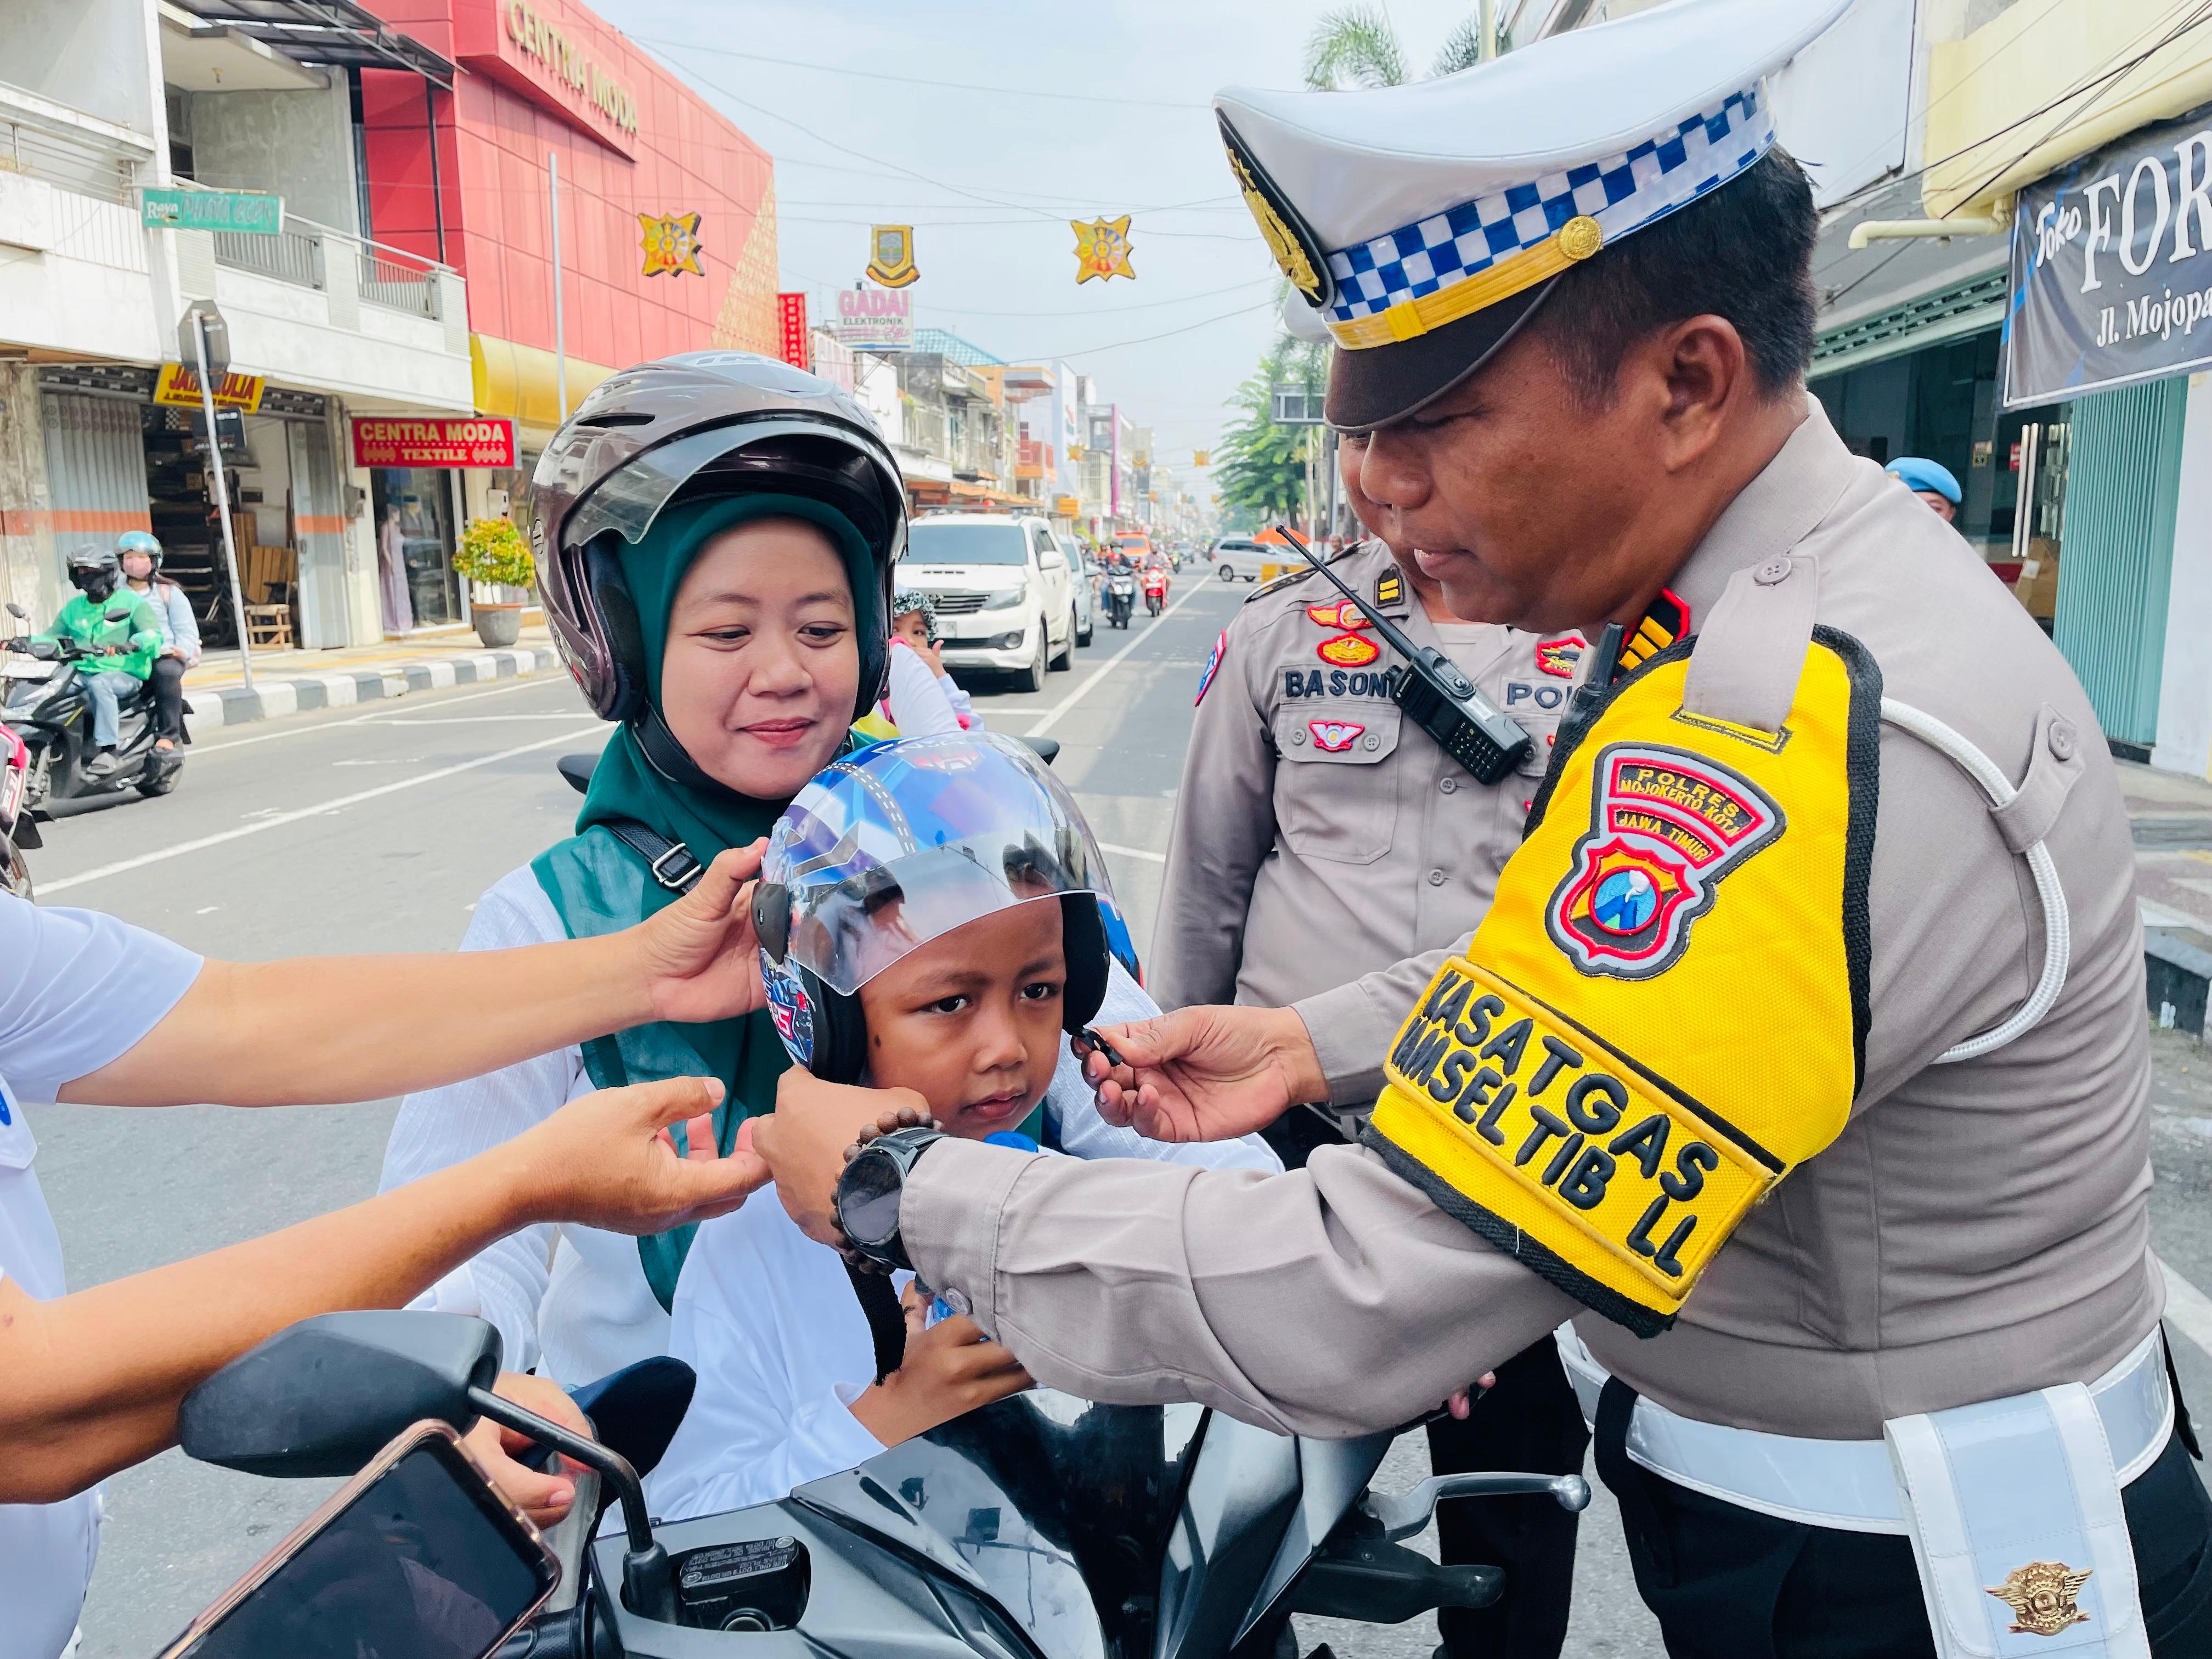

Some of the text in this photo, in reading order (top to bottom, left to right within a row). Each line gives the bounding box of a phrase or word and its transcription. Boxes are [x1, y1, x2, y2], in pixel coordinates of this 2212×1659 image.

[507, 0, 640, 137] CENTRA MODA
[838, 290, 909, 317] GADAI
[360, 423, 506, 442] CENTRA MODA
[400, 448, 468, 461] TEXTILE
[1285, 670, 1395, 698] BASON
[1621, 778, 1740, 836] MOJOKERTO KOTA
[1637, 769, 1740, 818] POLRES
[1620, 812, 1709, 861] JAWA TIMUR
[1515, 1105, 1616, 1210] TIB
[1626, 1194, 1697, 1277] LL
